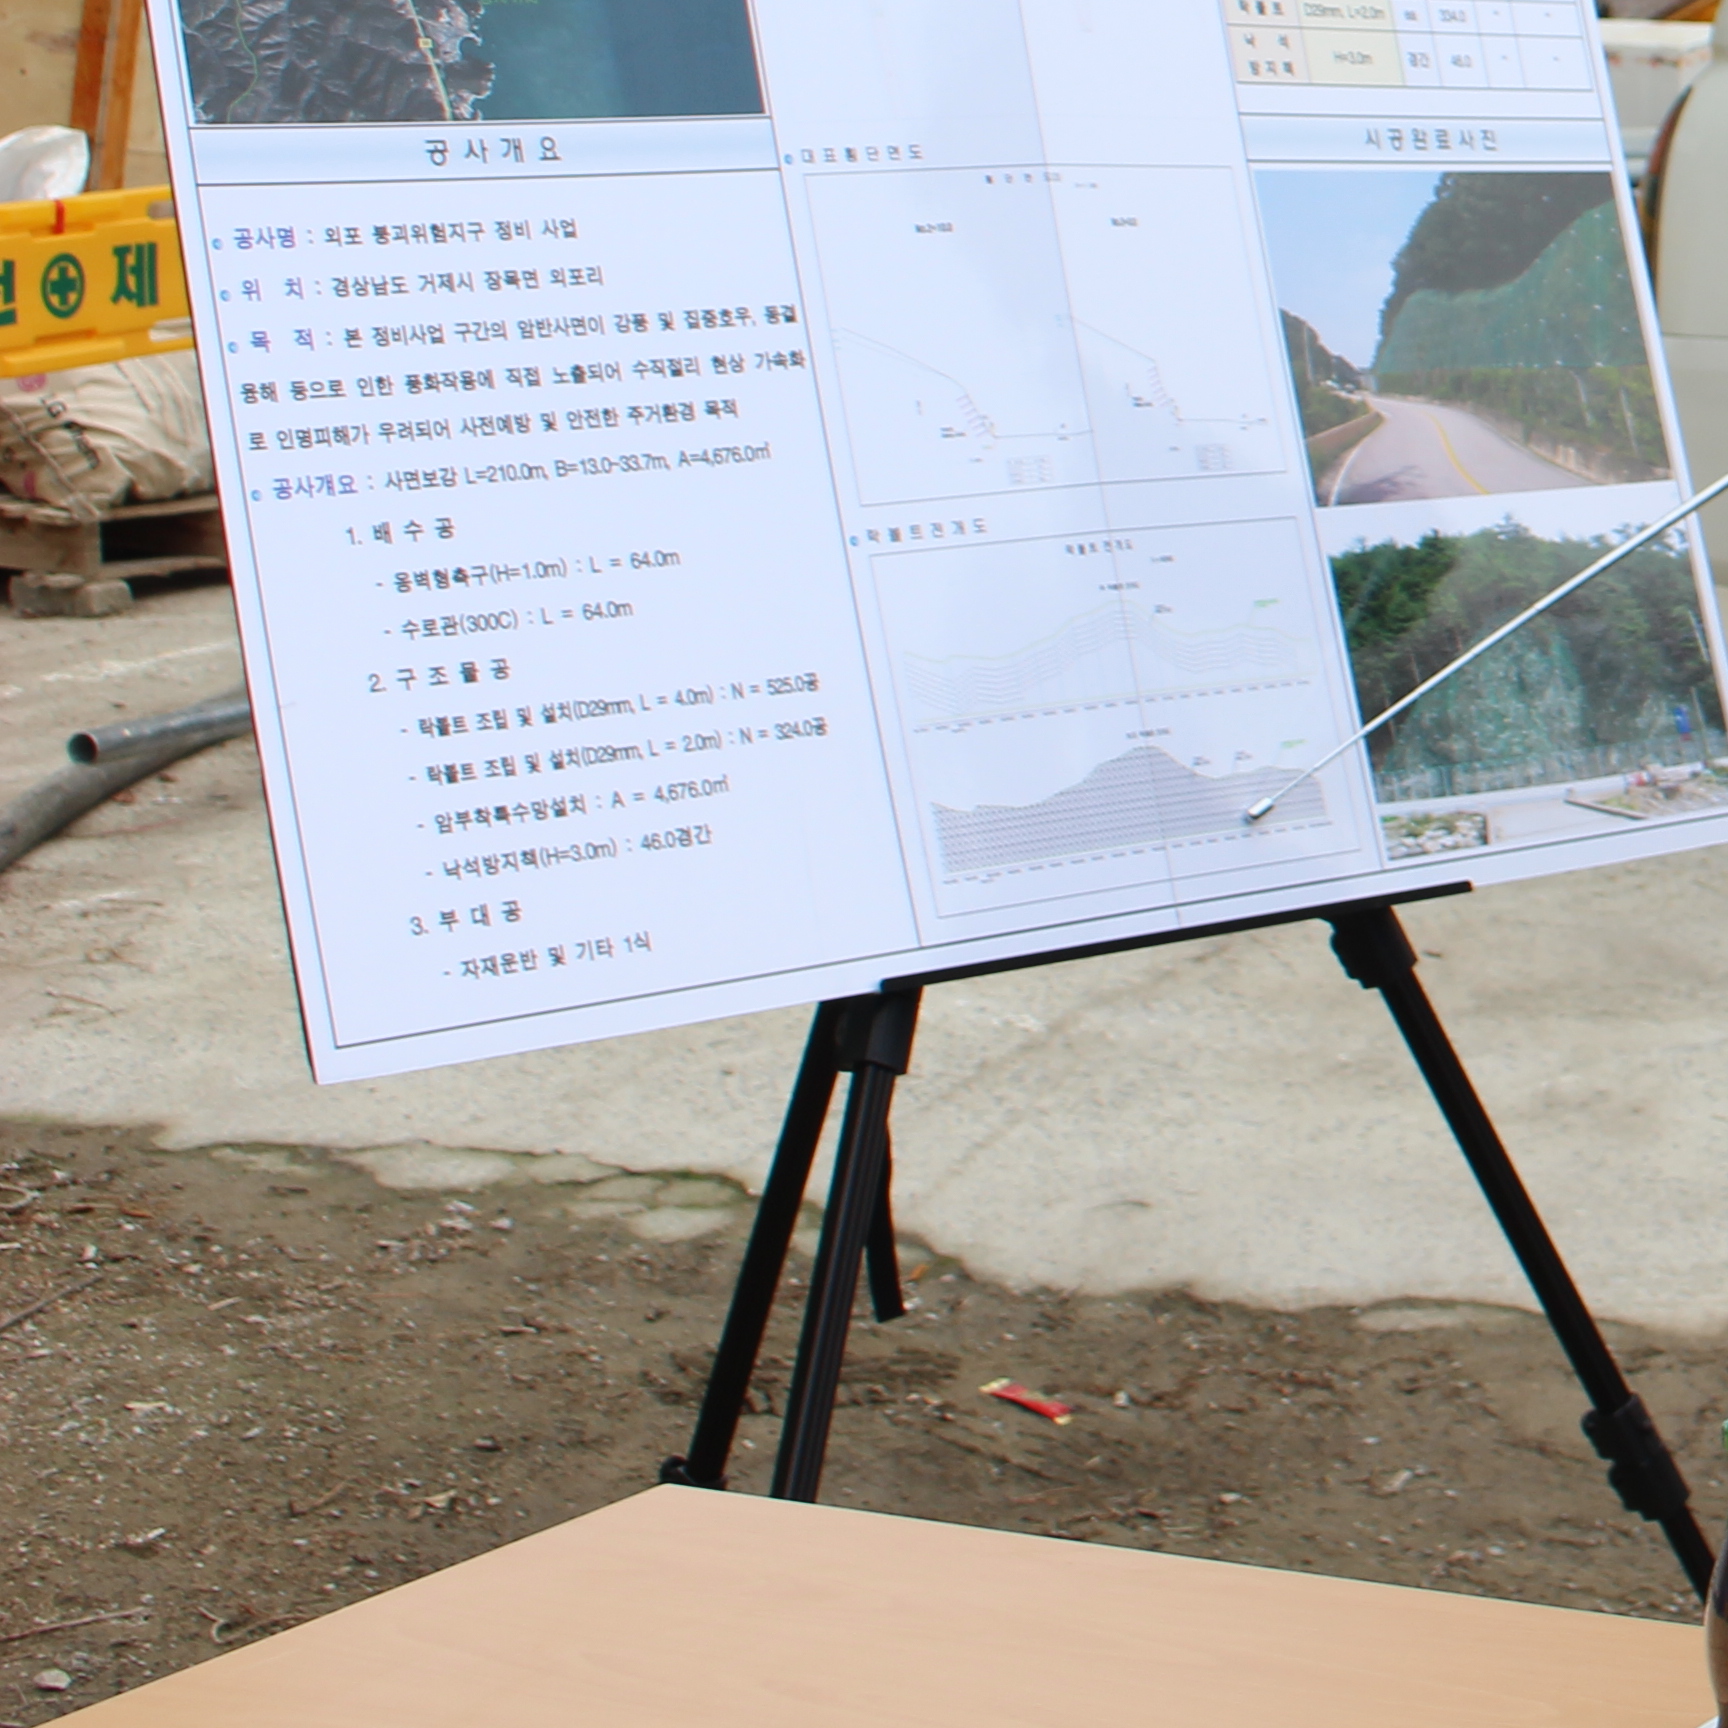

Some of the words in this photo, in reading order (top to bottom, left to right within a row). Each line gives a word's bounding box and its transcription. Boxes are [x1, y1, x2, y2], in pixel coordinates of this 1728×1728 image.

[424, 135, 562, 167] 공사개요
[1364, 127, 1498, 152] 시공완료사진
[324, 226, 363, 247] 외포
[371, 221, 485, 246] 붕괴위험지구
[494, 219, 532, 242] 정비
[541, 218, 578, 239] 사업
[331, 275, 410, 299] 경상남도
[417, 271, 475, 294] 거제시
[483, 269, 539, 292] 장목면
[549, 265, 604, 288] 외포리
[343, 328, 363, 349] 본
[371, 323, 445, 348] 정비사업
[453, 319, 509, 343] 구간의
[516, 314, 605, 340] 암반사면이
[657, 311, 675, 332] 및
[683, 306, 756, 330] 집중호우,
[764, 304, 798, 325] 동결
[239, 381, 279, 405] 융해
[289, 379, 347, 402] 등으로
[356, 375, 394, 398] 인한
[404, 368, 495, 395] 풍화작용에
[505, 366, 542, 388] 직접
[552, 362, 622, 385] 노출되어
[632, 356, 701, 380] 수직절리
[710, 353, 745, 375] 현상
[754, 349, 806, 371] 가속화
[248, 431, 268, 452] 로
[275, 423, 370, 451] 인명피해가
[377, 418, 452, 444] 우려되어
[459, 413, 531, 438] 사전예방
[539, 411, 558, 433] 및
[565, 407, 619, 431] 안전한
[626, 401, 696, 426] 주거환경
[704, 399, 738, 419] 목적
[384, 466, 458, 492] 사면보강
[629, 549, 681, 570] 64.0m
[581, 600, 634, 622] 64.0m
[475, 708, 509, 732] 조립
[515, 706, 533, 728] 및
[484, 755, 517, 779] 조립
[524, 753, 541, 774] 및
[460, 948, 538, 980] 자재운반
[547, 945, 566, 967] 및
[574, 936, 614, 962] 기타
